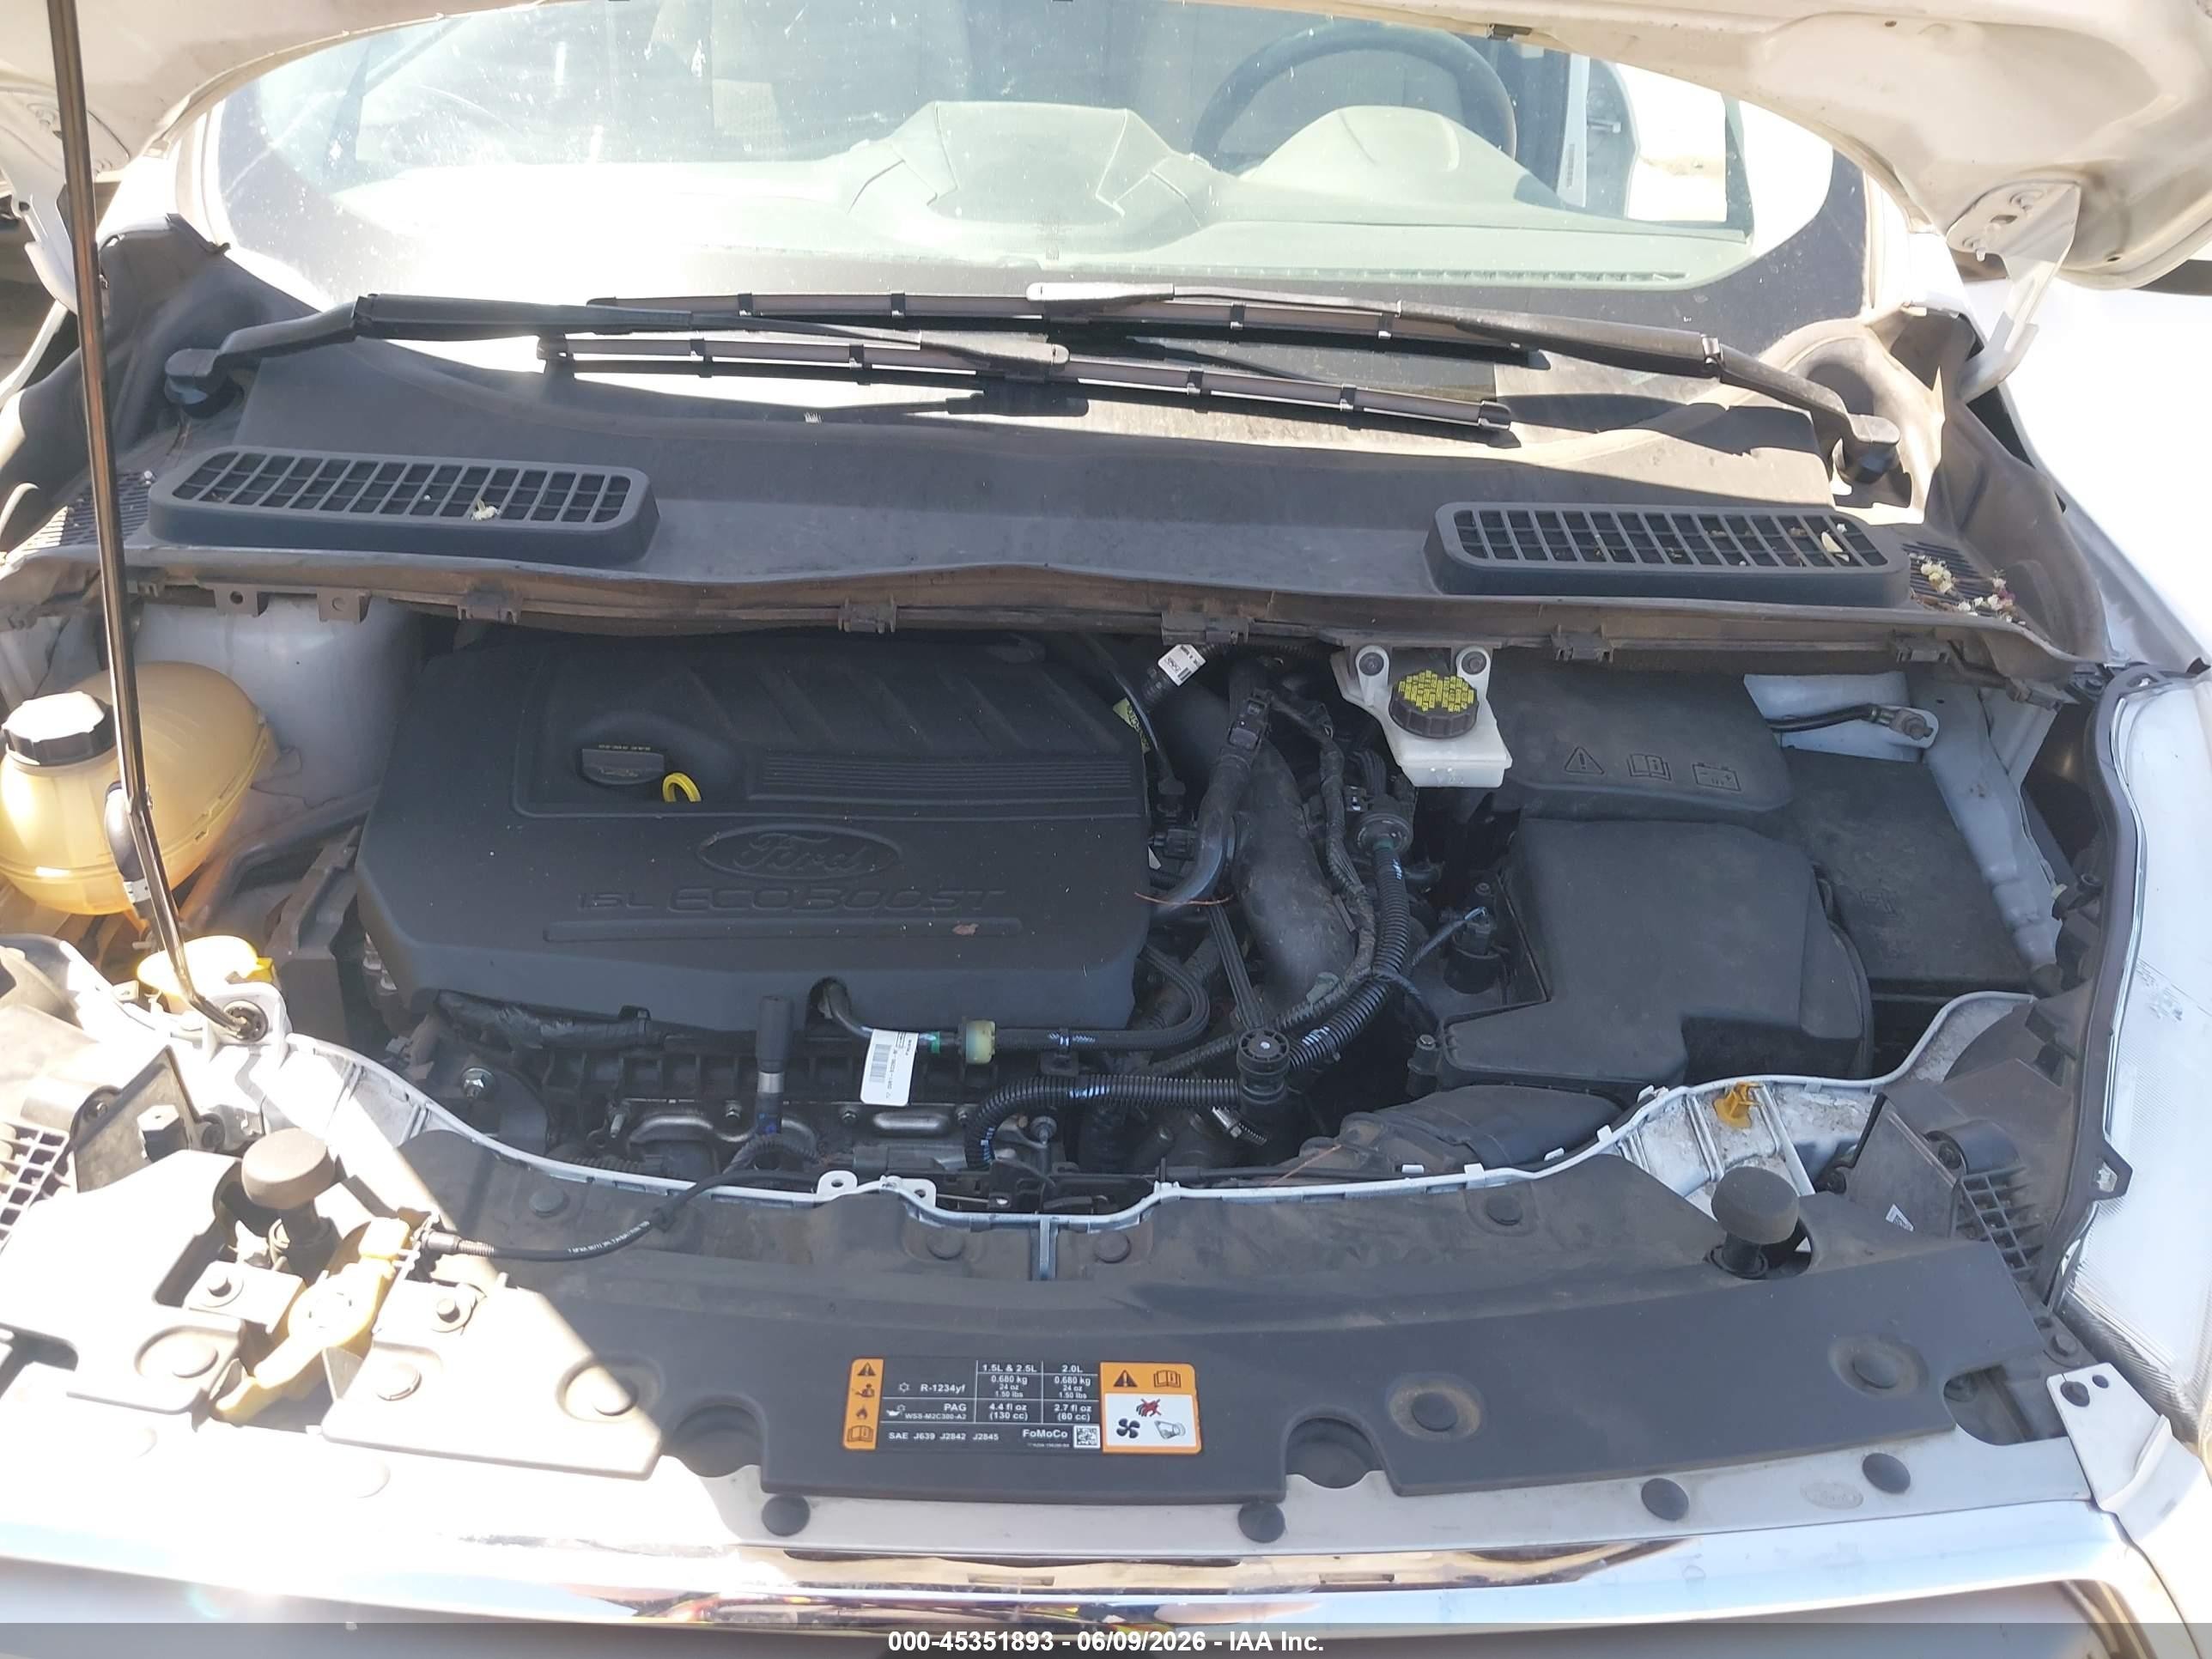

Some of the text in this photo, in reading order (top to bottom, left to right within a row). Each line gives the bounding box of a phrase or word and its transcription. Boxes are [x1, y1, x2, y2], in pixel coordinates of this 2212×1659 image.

[982, 1364, 1003, 1372] 1.5L
[1016, 1364, 1037, 1373] 2.5L
[1061, 1364, 1083, 1373] 2.0L
[991, 1375, 1028, 1385] 0.680 kg
[1079, 1376, 1091, 1386] kg
[921, 1383, 966, 1395] R-1234yf
[944, 1403, 967, 1412] PAG
[989, 1412, 1029, 1421] (130 cc)
[1075, 1413, 1091, 1422] cc)
[914, 1432, 936, 1441] J639
[1023, 1428, 1068, 1438] FoMoCo
